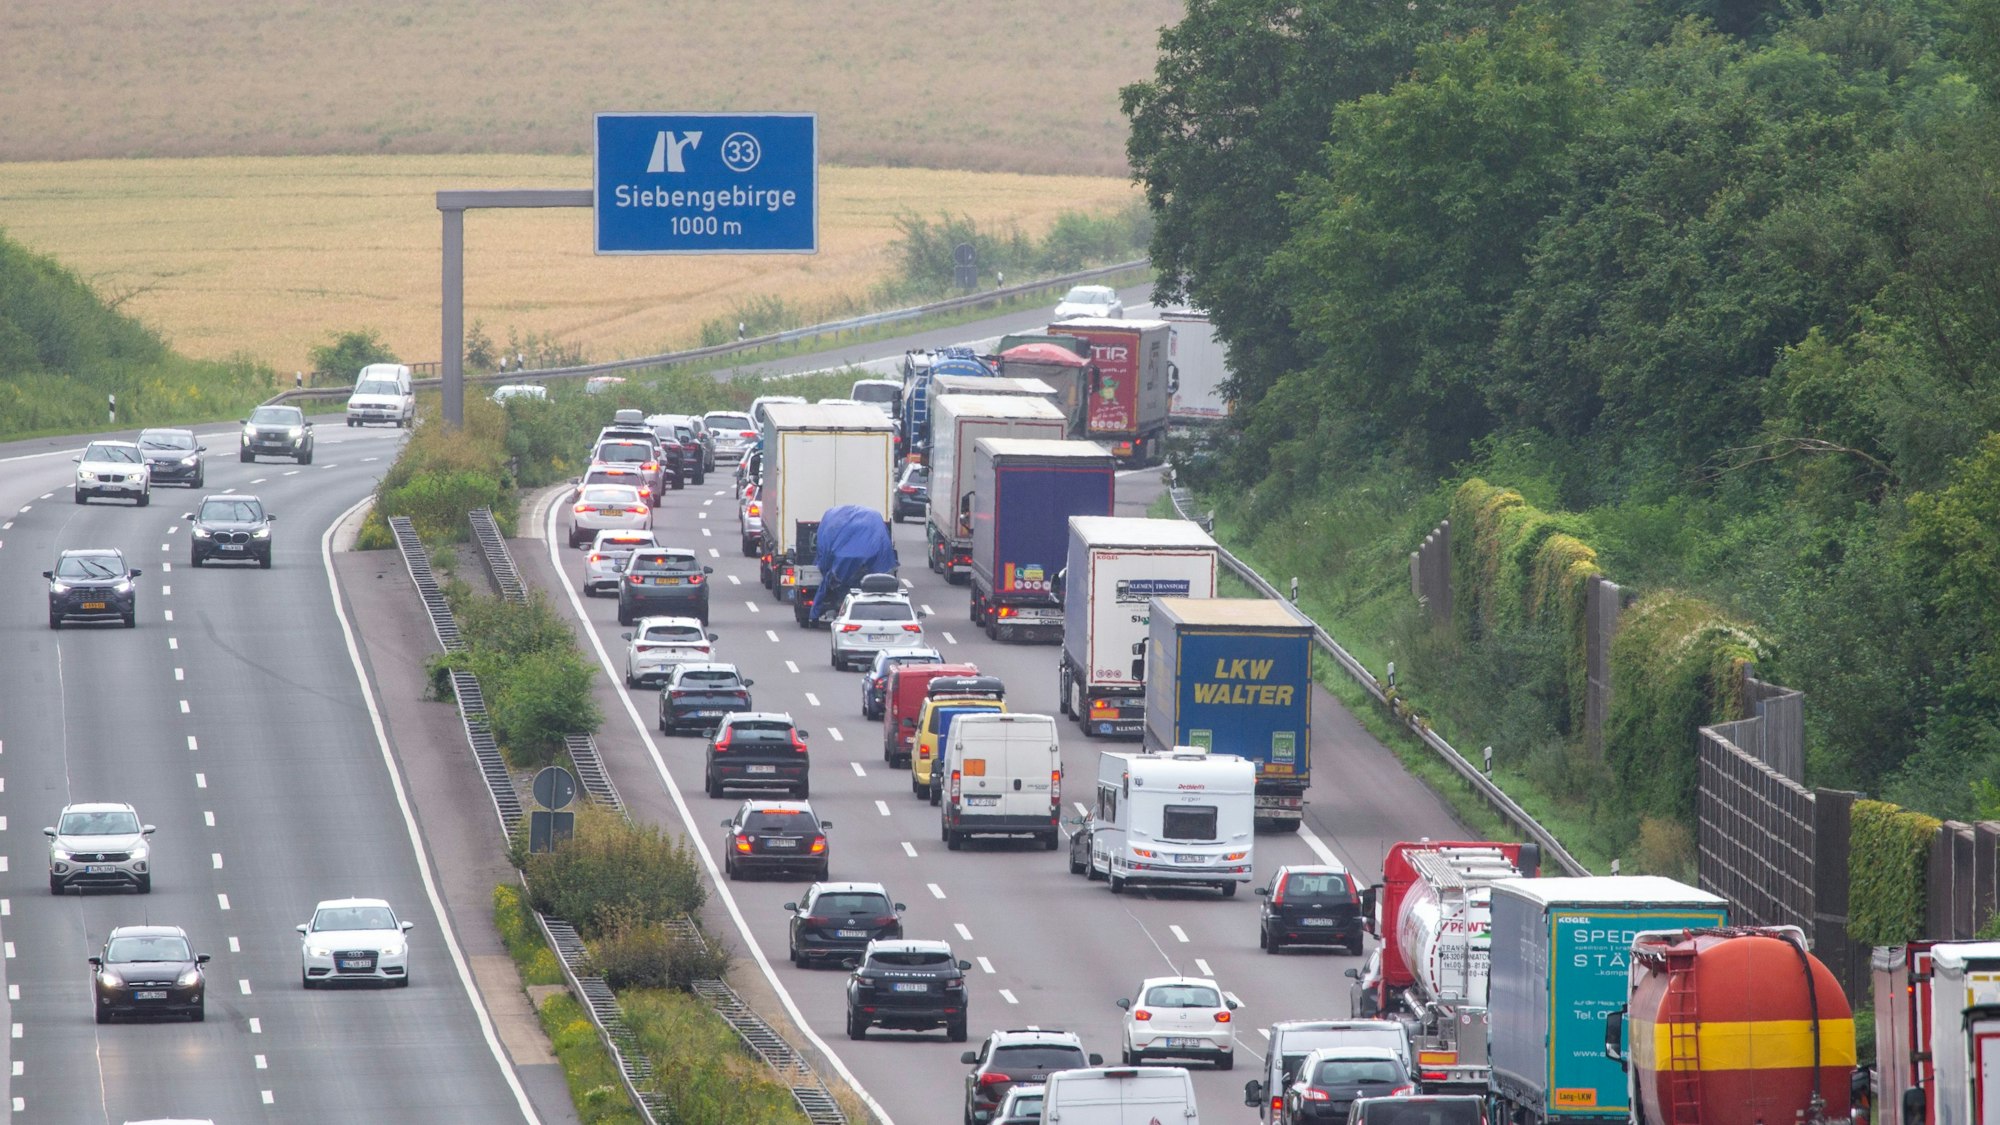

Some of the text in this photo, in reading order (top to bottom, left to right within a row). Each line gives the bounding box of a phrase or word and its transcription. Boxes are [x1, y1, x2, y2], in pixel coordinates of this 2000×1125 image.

[727, 140, 755, 163] 33
[615, 184, 796, 212] Siebengebirge
[670, 216, 742, 235] 1000 m
[1214, 658, 1275, 680] LKW
[1193, 683, 1295, 706] WALTER
[1573, 952, 1626, 967] STÄ
